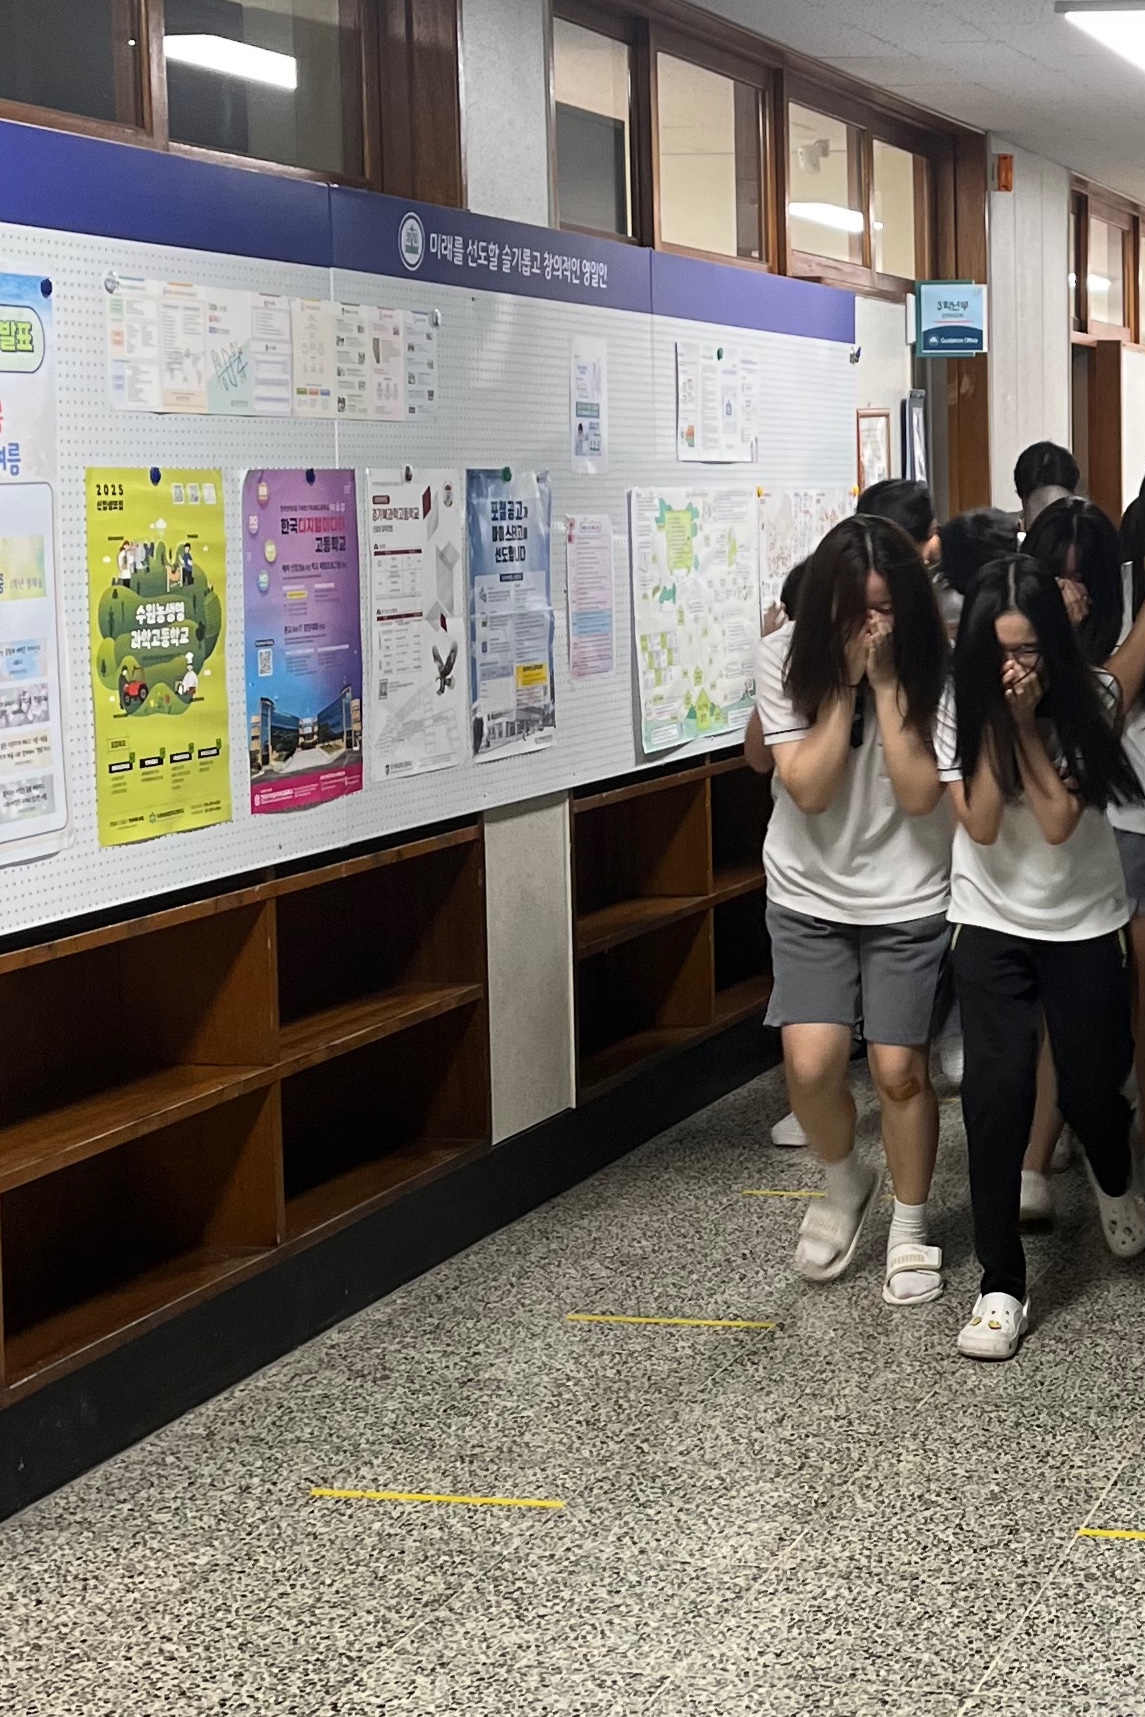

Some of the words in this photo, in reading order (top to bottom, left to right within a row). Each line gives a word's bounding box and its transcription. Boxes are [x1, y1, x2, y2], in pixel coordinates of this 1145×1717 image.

[430, 233, 464, 266] 미래를
[466, 239, 499, 271] 선도할
[501, 244, 541, 276] 슬기롭고
[543, 252, 581, 284] 창의적인
[582, 258, 608, 289] 영일인
[96, 483, 124, 496] 2025
[135, 601, 185, 625] 수원농생명
[131, 626, 190, 650] 과학고등학교
